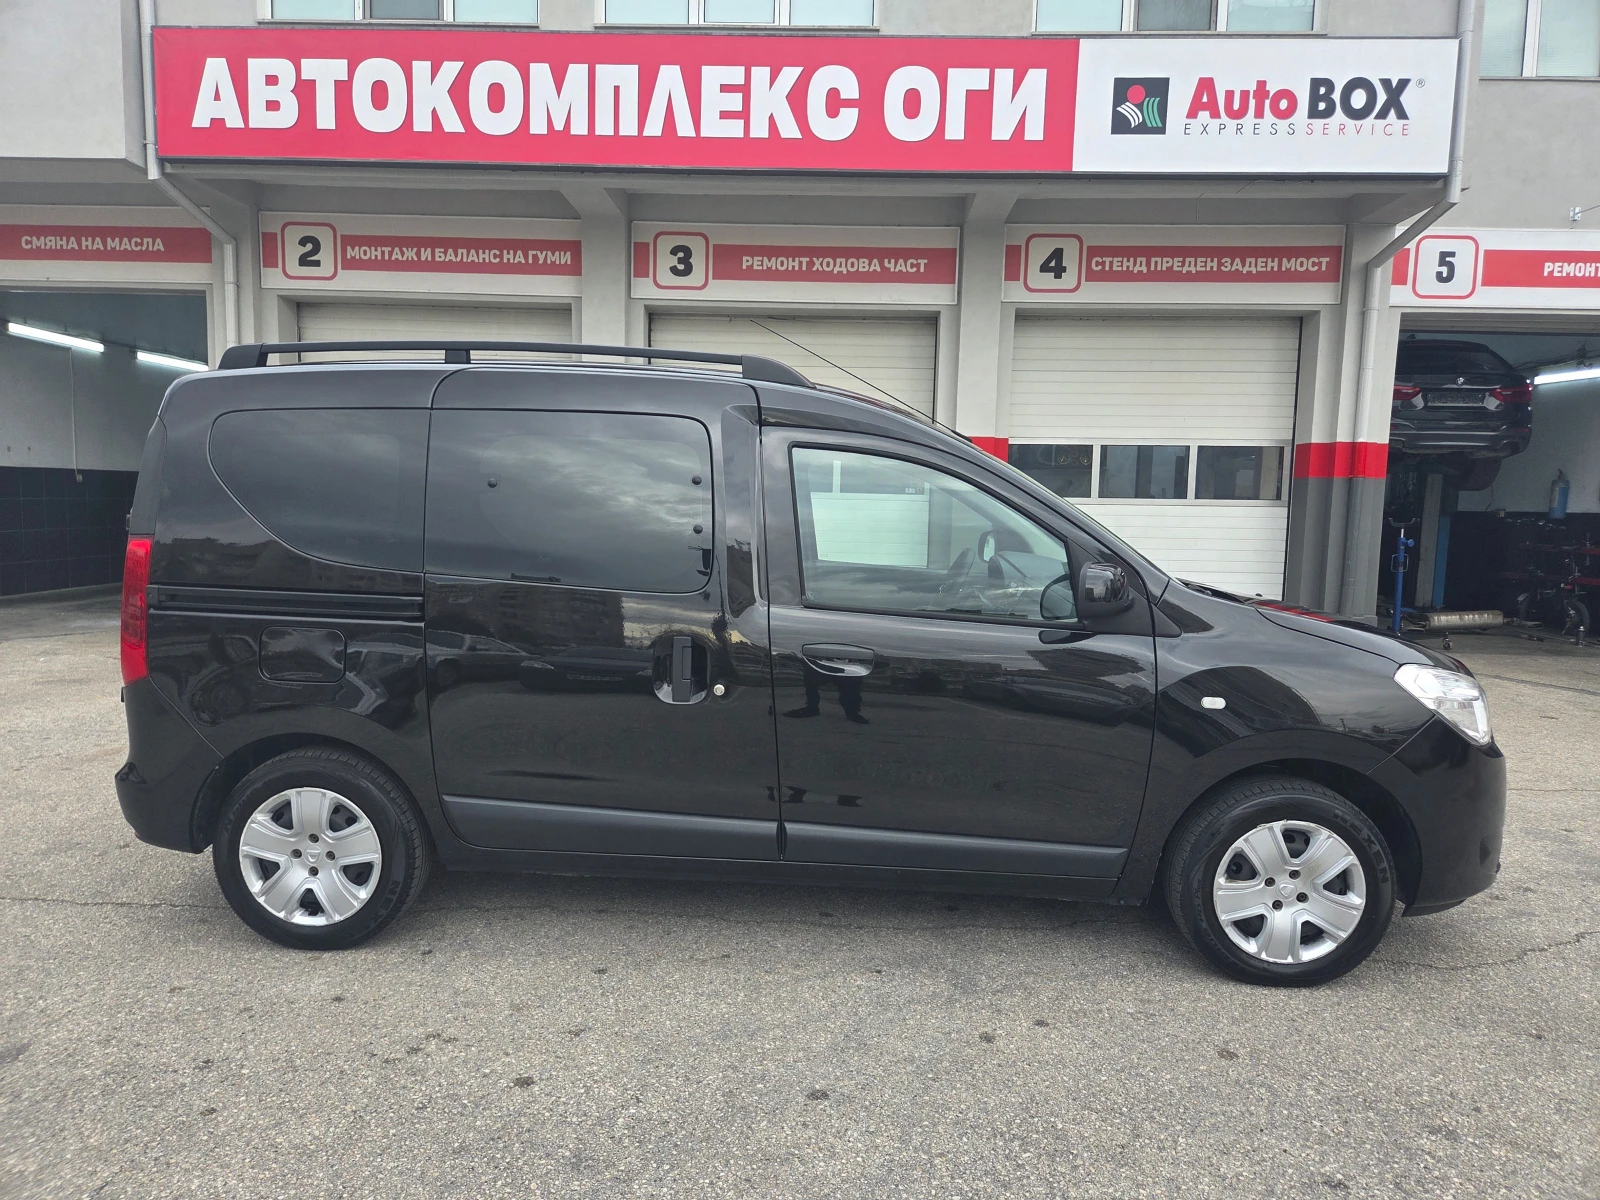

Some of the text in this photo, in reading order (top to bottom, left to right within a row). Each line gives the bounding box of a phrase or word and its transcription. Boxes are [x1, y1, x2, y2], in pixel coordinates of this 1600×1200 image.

[191, 57, 1048, 142] АВТОКОМПЛЕКС ОГИ
[1185, 76, 1299, 121] Auto
[1307, 76, 1412, 121] BOX
[1183, 122, 1410, 137] EXPRESS SERVICE
[21, 235, 165, 252] СМЯНА НА МАСЛА
[297, 235, 322, 268] 2
[346, 245, 572, 265] МОНТАЖ И БАЛАНС НА ГУМИ
[669, 244, 694, 277] 3
[742, 256, 928, 274] РЕМОНТ ХОДОВА ЧАСТ
[1039, 247, 1067, 280] 4
[1091, 257, 1330, 273] СТЕНД ПРЕДЕН ЗАДЕН МОСТ
[1435, 250, 1456, 285] 5
[1333, 809, 1390, 884] NEXEN
